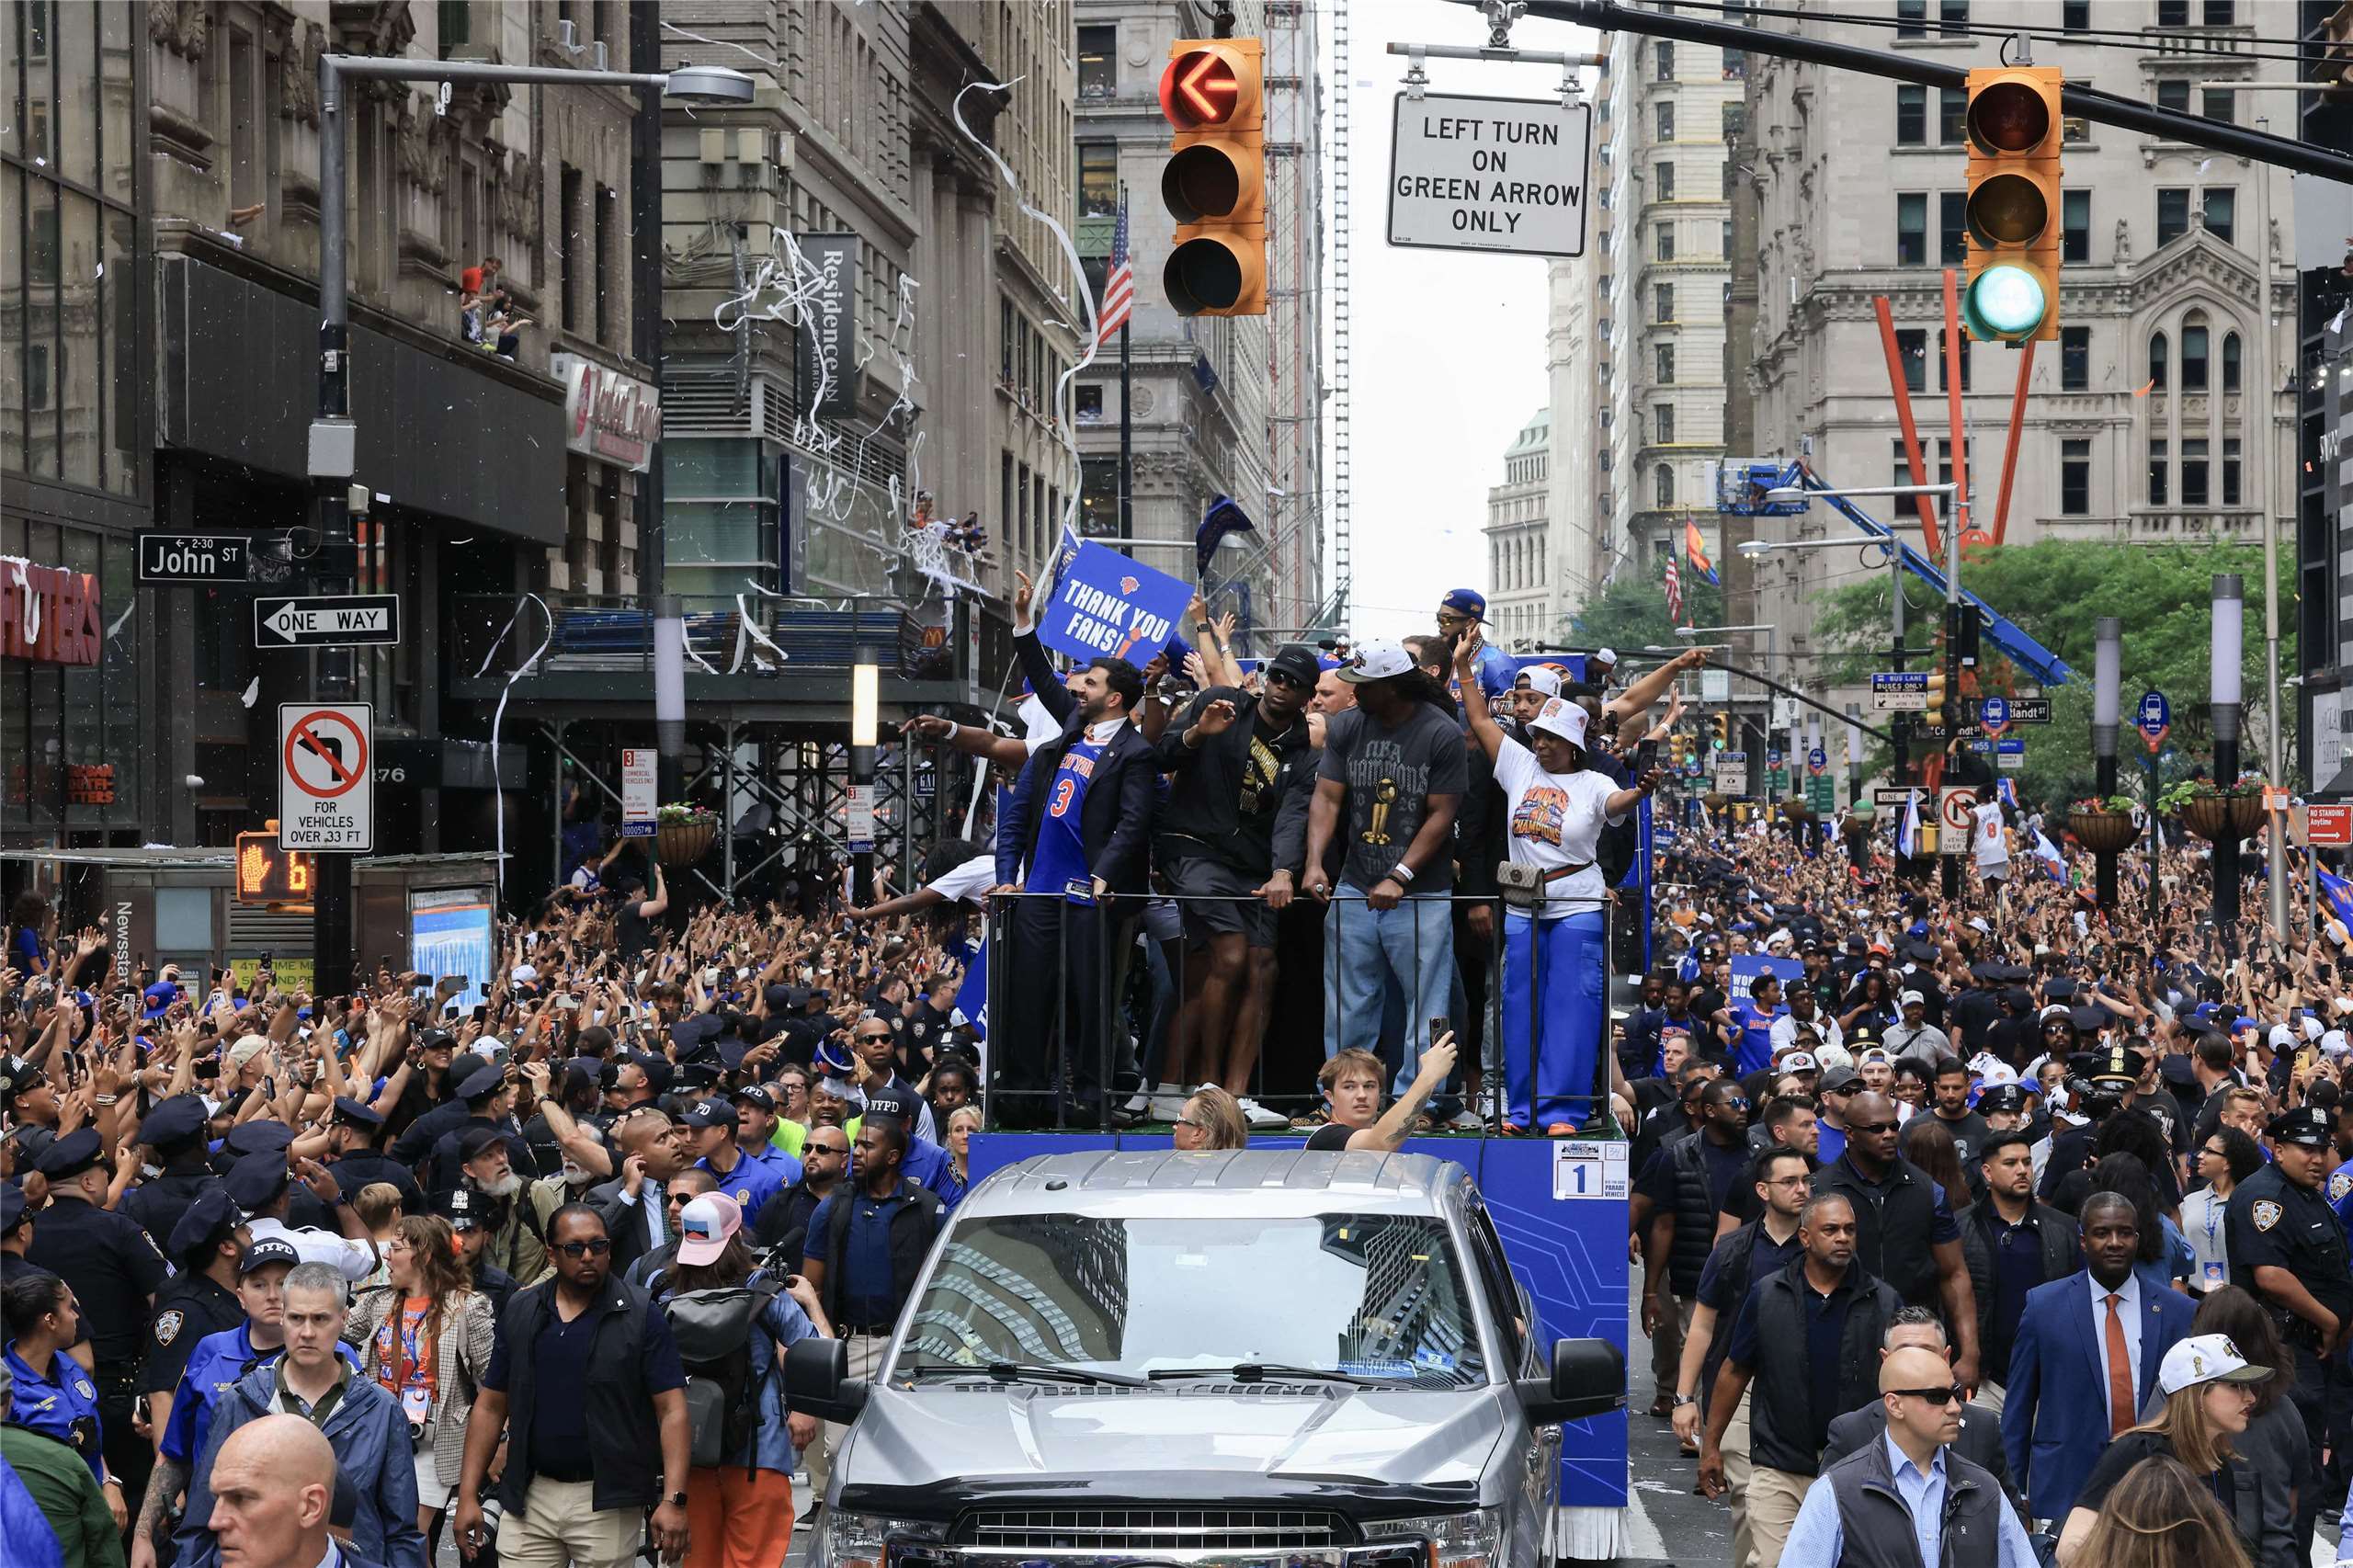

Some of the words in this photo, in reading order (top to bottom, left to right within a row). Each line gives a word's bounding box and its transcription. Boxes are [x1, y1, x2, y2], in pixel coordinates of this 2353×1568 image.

[1424, 117, 1483, 141] LEFT
[1492, 120, 1558, 145] TURN
[1472, 150, 1506, 173] ON
[1397, 175, 1480, 201] GREEN
[1490, 181, 1580, 207] ARROW
[1452, 209, 1521, 233] ONLY
[824, 250, 843, 370] Residence
[191, 539, 213, 549] 2-30
[150, 546, 215, 574] John
[222, 547, 238, 562] ST
[278, 613, 317, 631] ONE
[336, 611, 379, 630] WAY
[1063, 579, 1131, 626] THANK
[1129, 608, 1171, 643] YOU
[1065, 612, 1125, 655] FANS!
[2009, 709, 2038, 719] tlandt
[626, 752, 632, 766] 3
[1346, 754, 1431, 795] CHAMPIONS
[849, 788, 854, 798] 3
[1050, 778, 1074, 817] 3
[314, 801, 336, 813] FOR
[2310, 809, 2317, 817] NO
[2319, 809, 2345, 817] STANDING
[298, 816, 354, 827] VEHICLES
[625, 826, 644, 835] 100057
[2310, 818, 2332, 826] Anytime
[290, 831, 321, 843] OVER
[325, 831, 341, 843] 33
[347, 831, 361, 843] FT
[1512, 819, 1562, 845] CHAMPIONS
[117, 902, 132, 987] Newssta
[1749, 1019, 1765, 1029] NEW
[870, 1100, 900, 1113] NYPD
[1573, 1165, 1586, 1194] 1
[254, 1242, 294, 1256] NYPD
